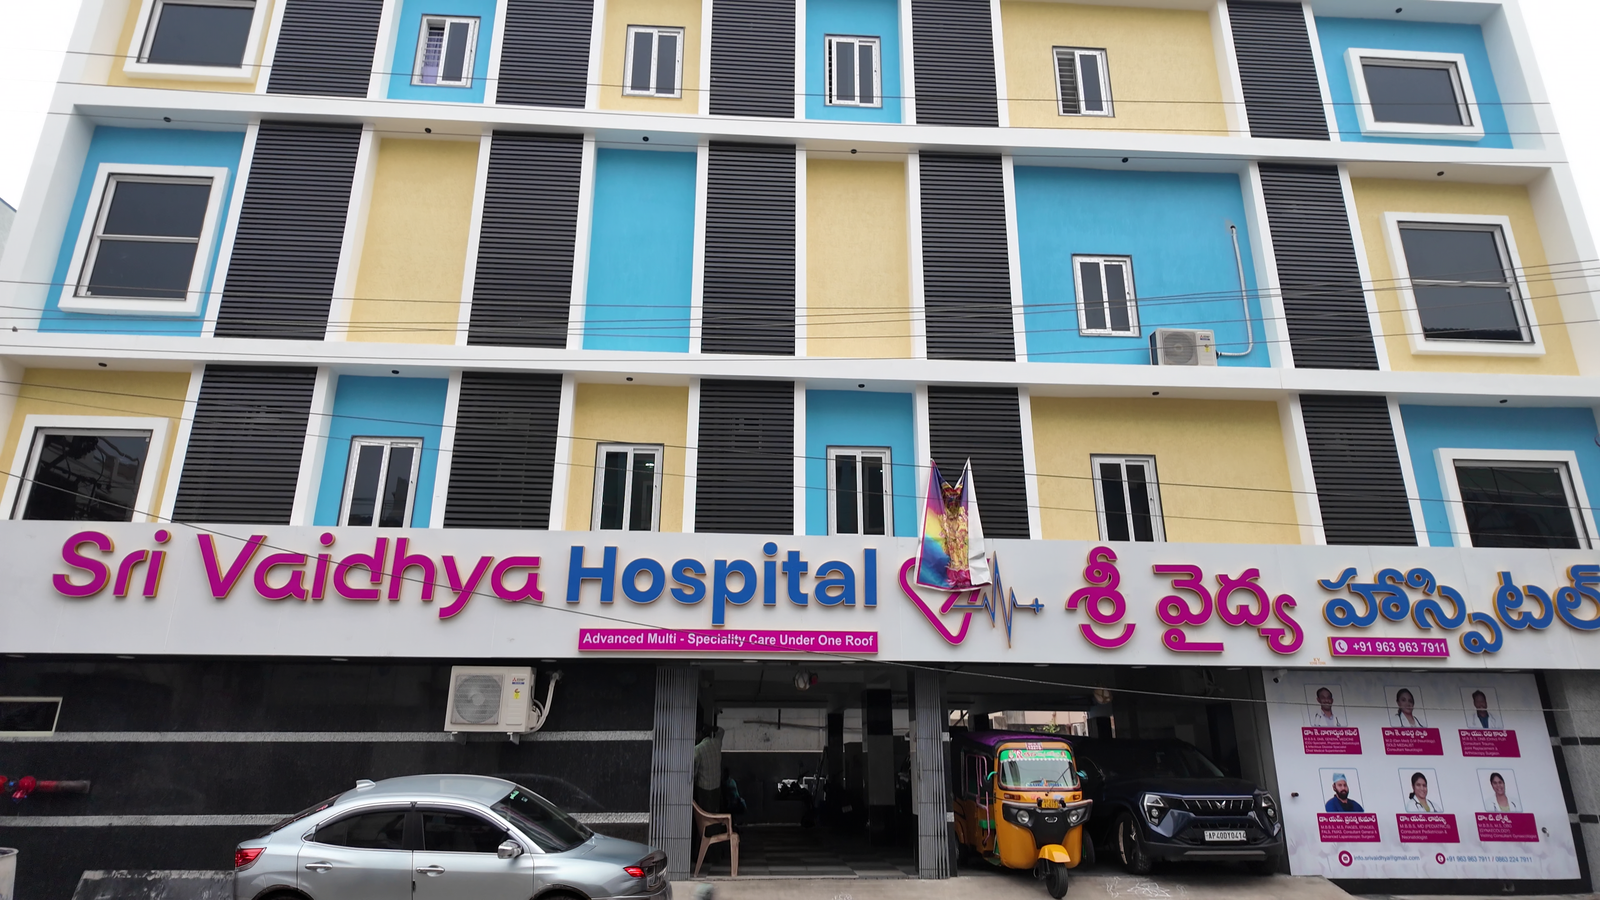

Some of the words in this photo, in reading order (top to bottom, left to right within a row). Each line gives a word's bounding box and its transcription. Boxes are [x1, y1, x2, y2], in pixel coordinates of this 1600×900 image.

[53, 530, 169, 598] Sri
[198, 532, 543, 619] Vaidhya
[566, 543, 878, 626] Hospital
[1066, 546, 1135, 648] శ్రీ
[1152, 564, 1304, 655] వైద్య
[1319, 565, 1600, 655] హాస్పిటల్
[583, 634, 644, 644] Advanced
[647, 634, 676, 644] Multi
[687, 634, 745, 647] Speciality
[749, 634, 776, 645] Care
[779, 634, 814, 645] Under
[818, 635, 841, 646] One
[845, 635, 873, 646] Roof
[1353, 642, 1372, 652] +91
[1376, 642, 1396, 652] 963
[1399, 642, 1418, 652] 963
[1421, 642, 1446, 653] 7911
